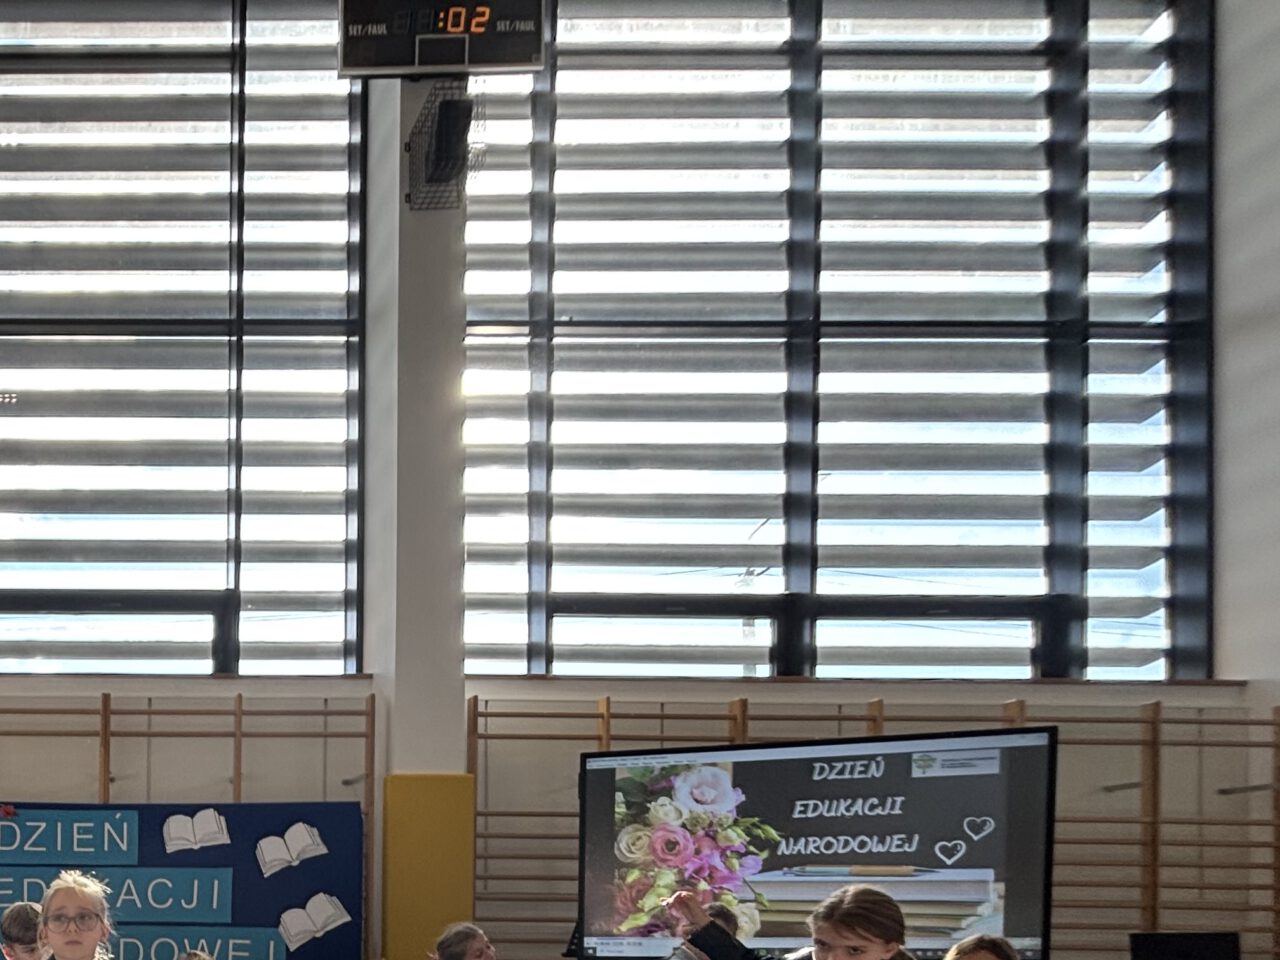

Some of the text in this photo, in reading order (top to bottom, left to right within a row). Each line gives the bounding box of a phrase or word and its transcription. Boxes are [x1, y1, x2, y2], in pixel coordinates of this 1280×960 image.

[812, 756, 885, 781] DZIEŃ
[792, 796, 906, 818] EDUKACJI
[777, 833, 920, 856] NARODOWEJ
